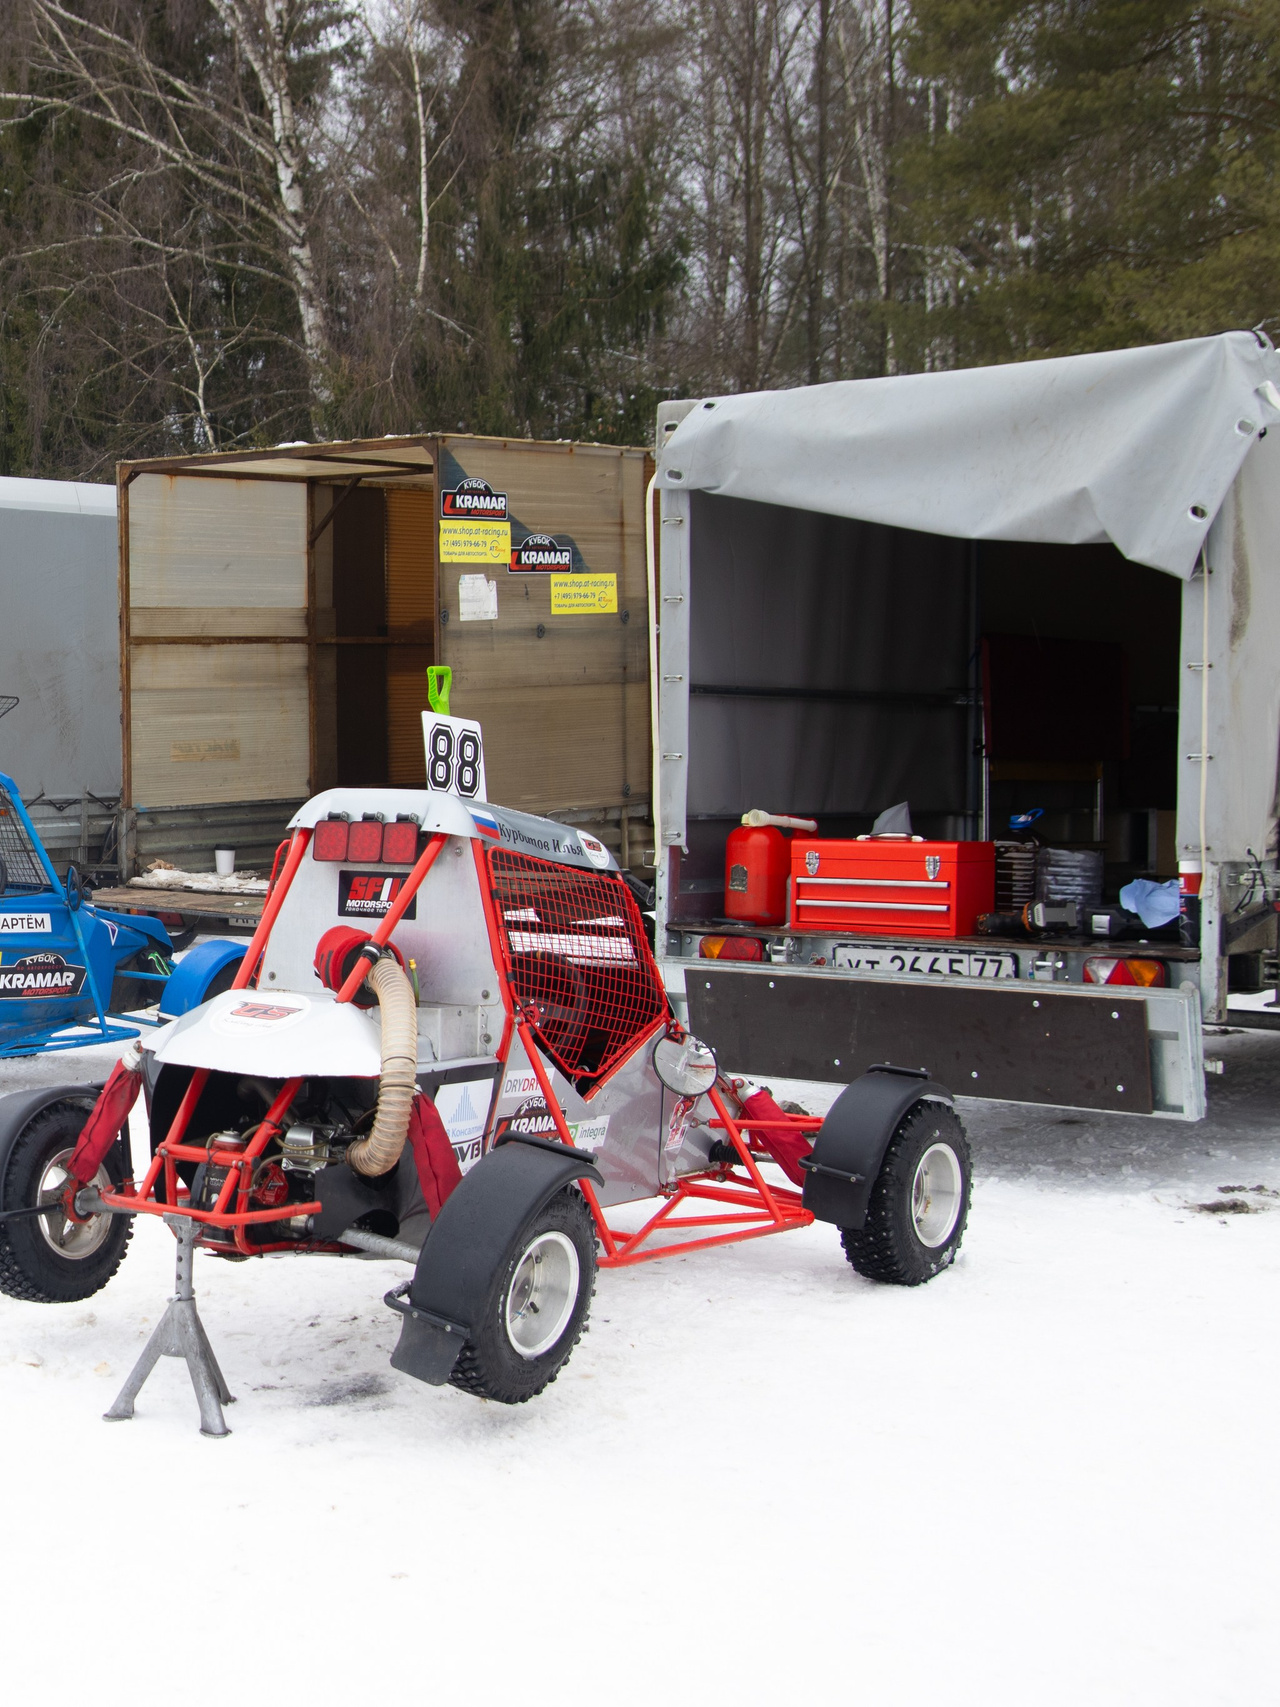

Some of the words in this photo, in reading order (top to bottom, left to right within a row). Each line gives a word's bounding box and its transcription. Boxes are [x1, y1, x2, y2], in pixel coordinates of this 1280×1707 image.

[463, 480, 486, 490] КУБОК
[456, 495, 505, 510] KRAMAR
[442, 526, 508, 538] www.shop.at-racing.ru
[528, 536, 551, 546] КУБОК
[521, 551, 570, 564] KRAMAR
[427, 722, 481, 799] 88
[552, 837, 584, 857] Илья
[346, 899, 393, 909] MOTORSPO
[0, 914, 45, 930] АРТЁМ
[25, 953, 57, 966] КУБОК
[973, 957, 1003, 978] 77
[0, 972, 76, 990] KRAMAR
[21, 986, 71, 996] MOTORSPORT
[578, 1125, 606, 1140] integra
